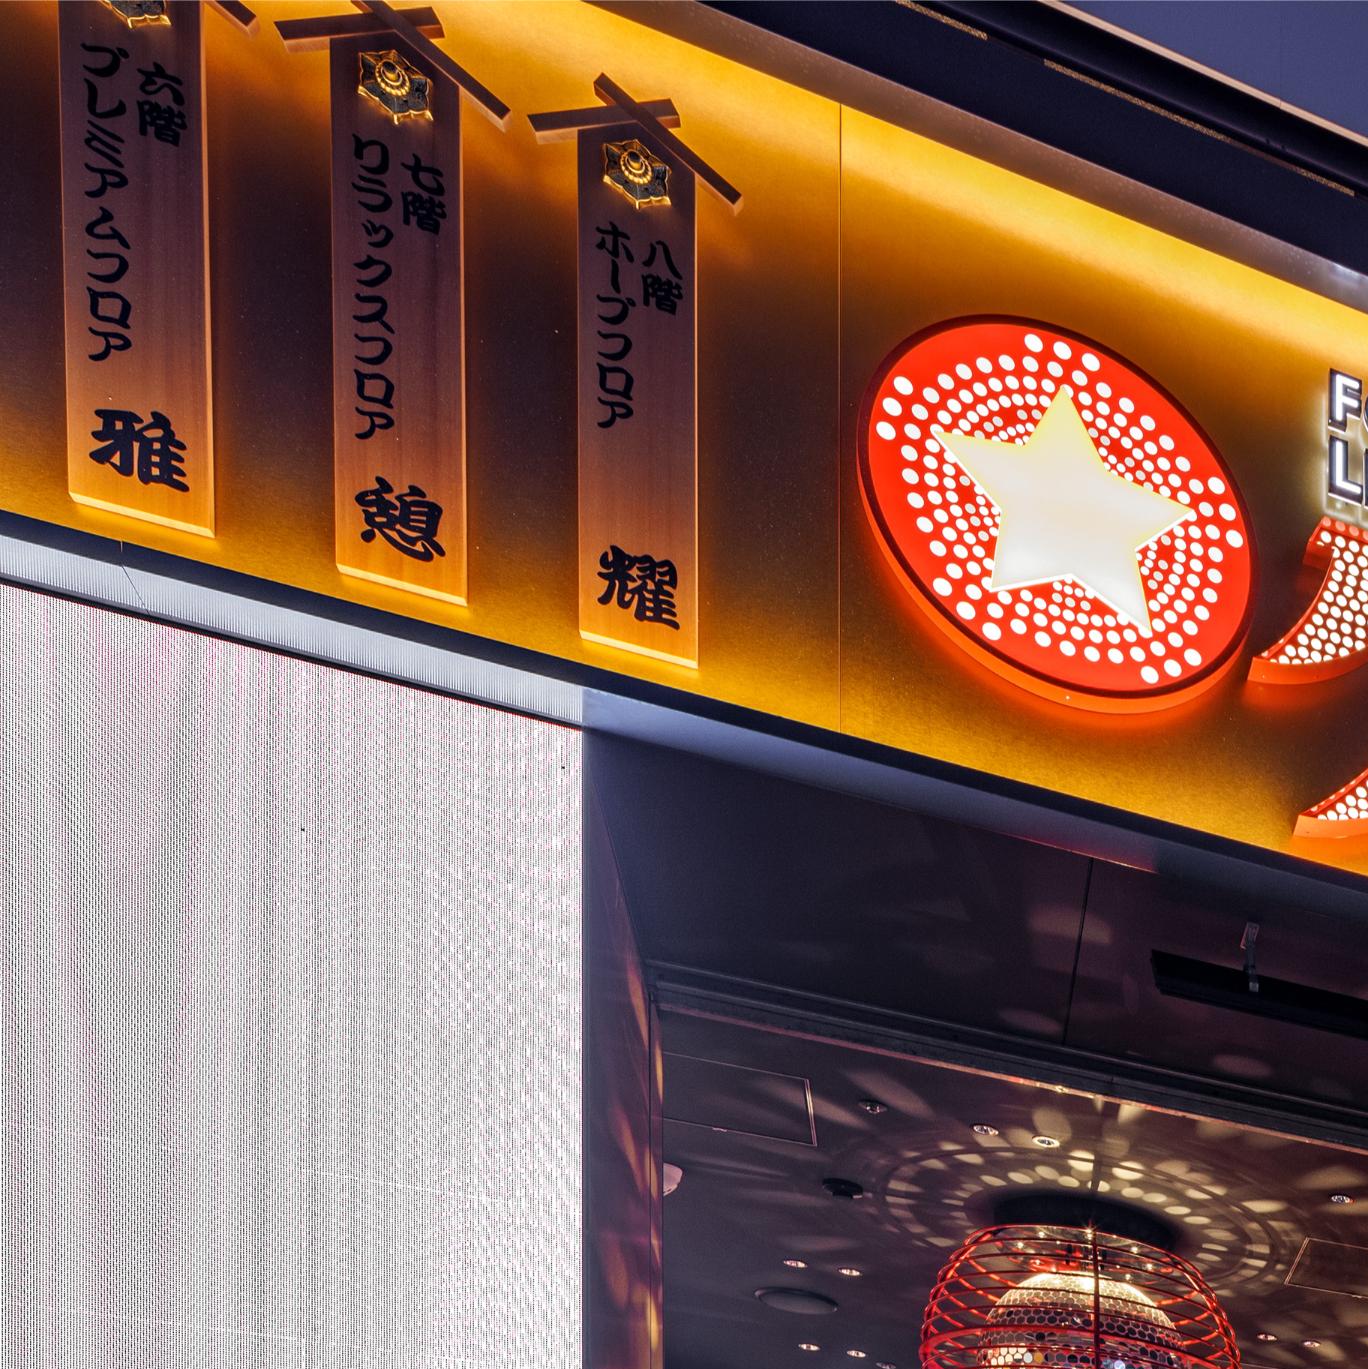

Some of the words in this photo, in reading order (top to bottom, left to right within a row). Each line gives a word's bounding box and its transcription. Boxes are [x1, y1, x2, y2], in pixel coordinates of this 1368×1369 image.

[136, 61, 188, 148] 六階
[401, 154, 448, 236] 七階
[351, 133, 395, 441] リラックスフロア
[642, 240, 684, 316] 八階
[91, 409, 189, 492] 雅
[355, 475, 446, 561] 憩
